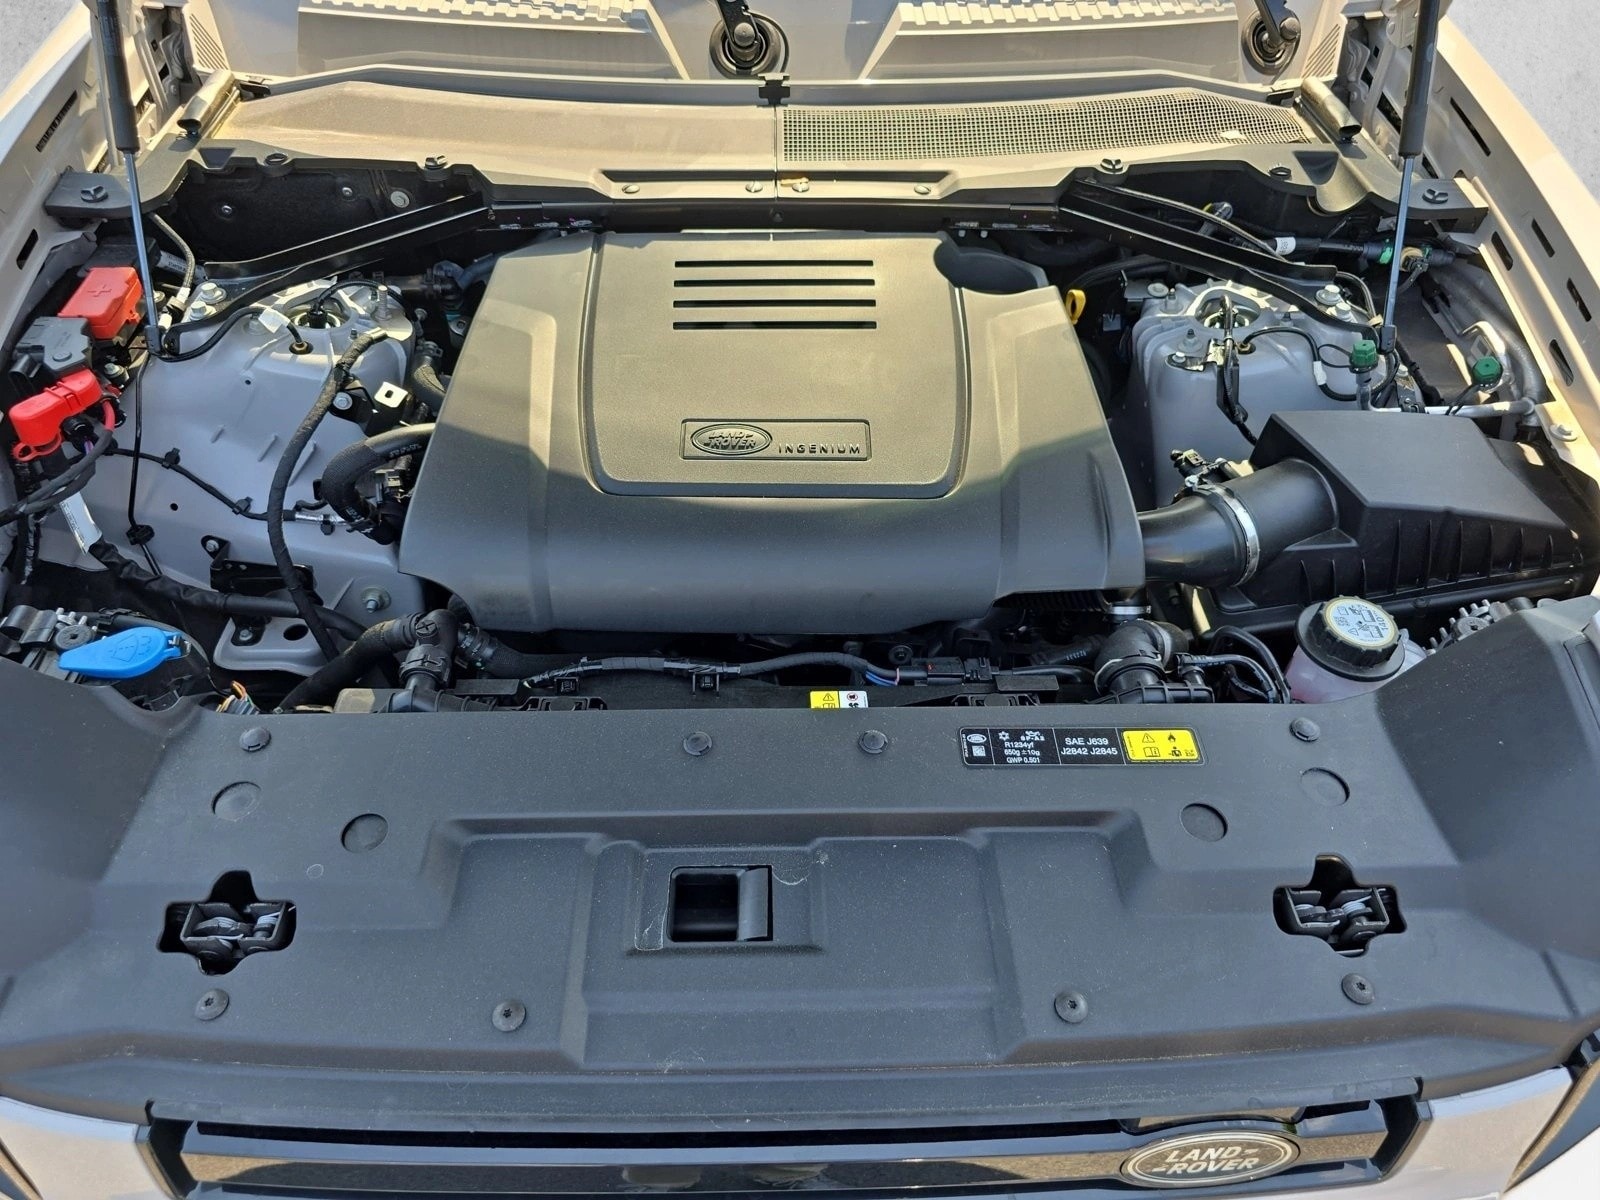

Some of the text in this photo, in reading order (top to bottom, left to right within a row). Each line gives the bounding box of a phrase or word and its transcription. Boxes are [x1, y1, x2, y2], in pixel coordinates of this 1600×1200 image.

[709, 430, 748, 439] LAND
[707, 438, 757, 450] ROVER
[778, 443, 861, 454] INGENIUM
[1004, 741, 1034, 749] R1234yf
[1064, 737, 1109, 745] SAE J639
[1061, 747, 1118, 755] J2842 J2845
[1165, 1146, 1243, 1163] LAND
[1166, 1157, 1260, 1175] ROVER
